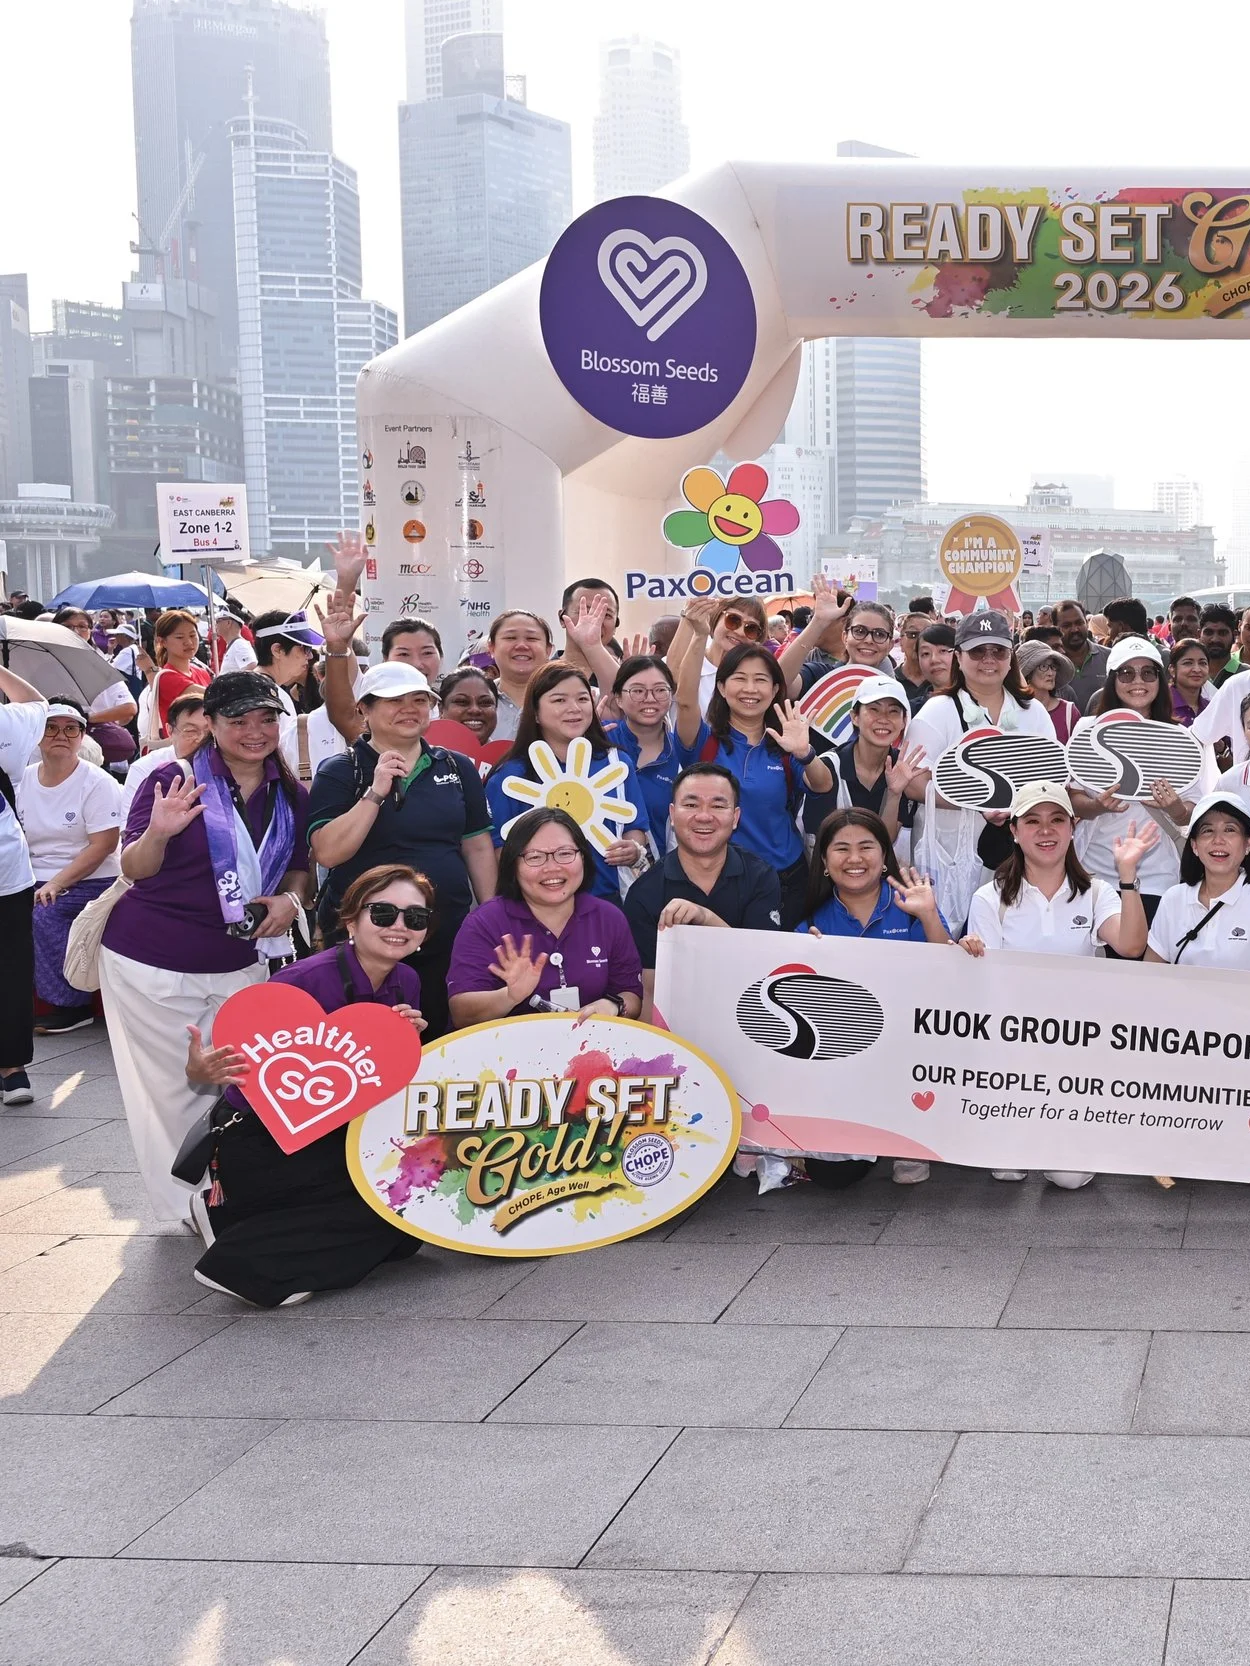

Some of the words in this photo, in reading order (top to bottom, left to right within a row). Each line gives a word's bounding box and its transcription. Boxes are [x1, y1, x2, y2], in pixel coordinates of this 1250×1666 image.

[846, 201, 1043, 264] READY
[1058, 201, 1173, 263] SET
[1053, 271, 1186, 312] 2026
[580, 349, 660, 378] Blossom
[665, 358, 719, 383] Seeds
[630, 382, 669, 406] 福善
[403, 425, 433, 433] Partners
[179, 522, 210, 534] Zone
[214, 521, 232, 533] 1-2
[193, 538, 210, 546] Bus
[944, 549, 1017, 561] COMMUNITY
[964, 537, 983, 549] I'M
[987, 537, 997, 549] A
[948, 561, 1014, 574] CHAMPION
[626, 570, 794, 598] PaxOcean
[467, 601, 490, 610] NHG
[913, 1008, 992, 1041] KUOK
[1000, 1015, 1101, 1047] GROUP
[240, 1022, 382, 1087] Healthier
[275, 1070, 335, 1106] SG
[912, 1064, 957, 1085] OUR
[962, 1069, 1052, 1096] PEOPLE,
[1058, 1075, 1104, 1096] OUR
[403, 1076, 577, 1134] READY
[586, 1075, 679, 1124] SET
[960, 1098, 1035, 1121] Together
[1040, 1103, 1064, 1121] for
[1068, 1109, 1079, 1122] a
[1084, 1107, 1135, 1126] better
[1139, 1111, 1223, 1131] tomorrow
[457, 1111, 626, 1205] Gold!
[625, 1147, 670, 1173] CHOPE
[626, 1137, 647, 1159] BLOSSOM
[648, 1137, 663, 1147] SEEDS
[508, 1191, 545, 1215] CHOPE,
[547, 1185, 566, 1197] Age
[568, 1181, 590, 1191] Well
